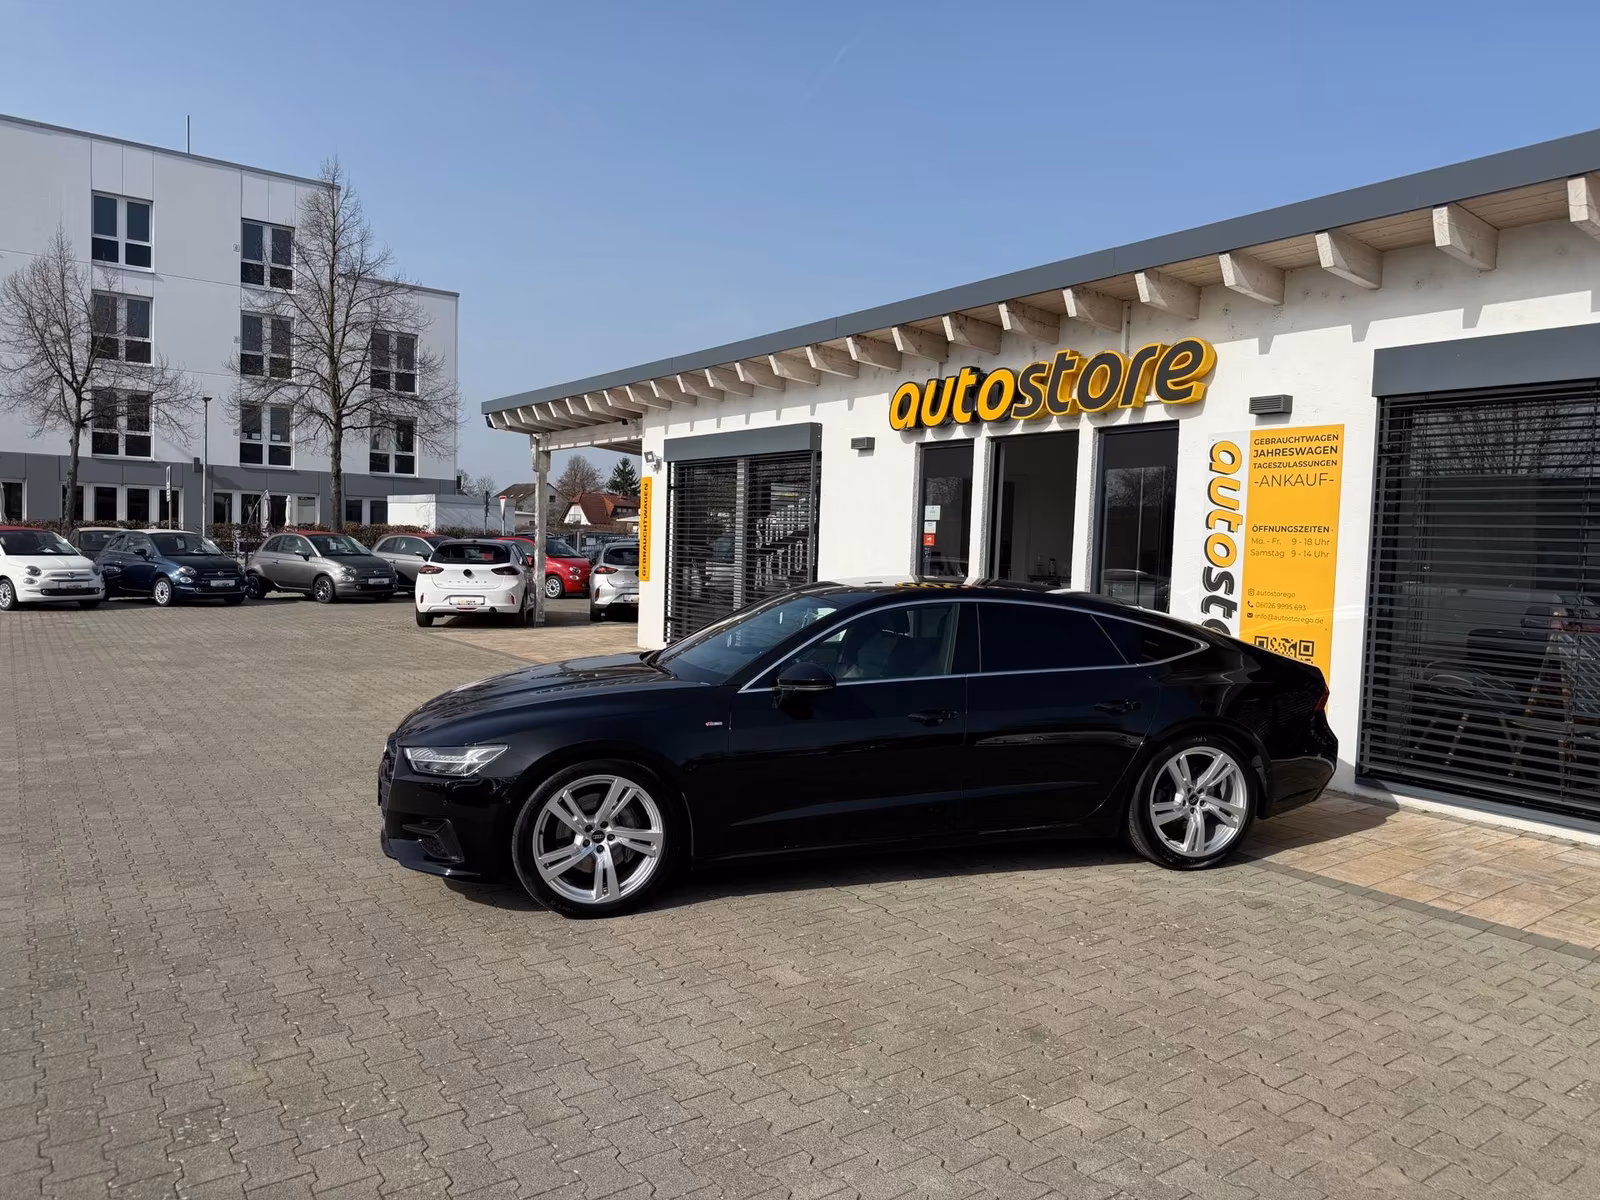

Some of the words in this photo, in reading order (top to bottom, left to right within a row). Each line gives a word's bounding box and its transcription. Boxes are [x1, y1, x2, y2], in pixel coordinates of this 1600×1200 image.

[889, 337, 1216, 431] autostore
[1253, 433, 1339, 446] GEBRAUCHTWAGEN
[1253, 445, 1338, 458] JAHRESWAGEN
[1253, 459, 1338, 470] TAGESZULASSUNGEN
[1254, 472, 1335, 488] -ANKAUF-
[1251, 523, 1330, 533] ÖFFNUNGSZEITEN
[1291, 537, 1297, 546] 9
[1304, 537, 1313, 546] 18
[1314, 537, 1330, 546] Uhr
[1250, 548, 1285, 559] Samstag
[1290, 549, 1297, 558] 9
[1313, 550, 1330, 558] Uhr
